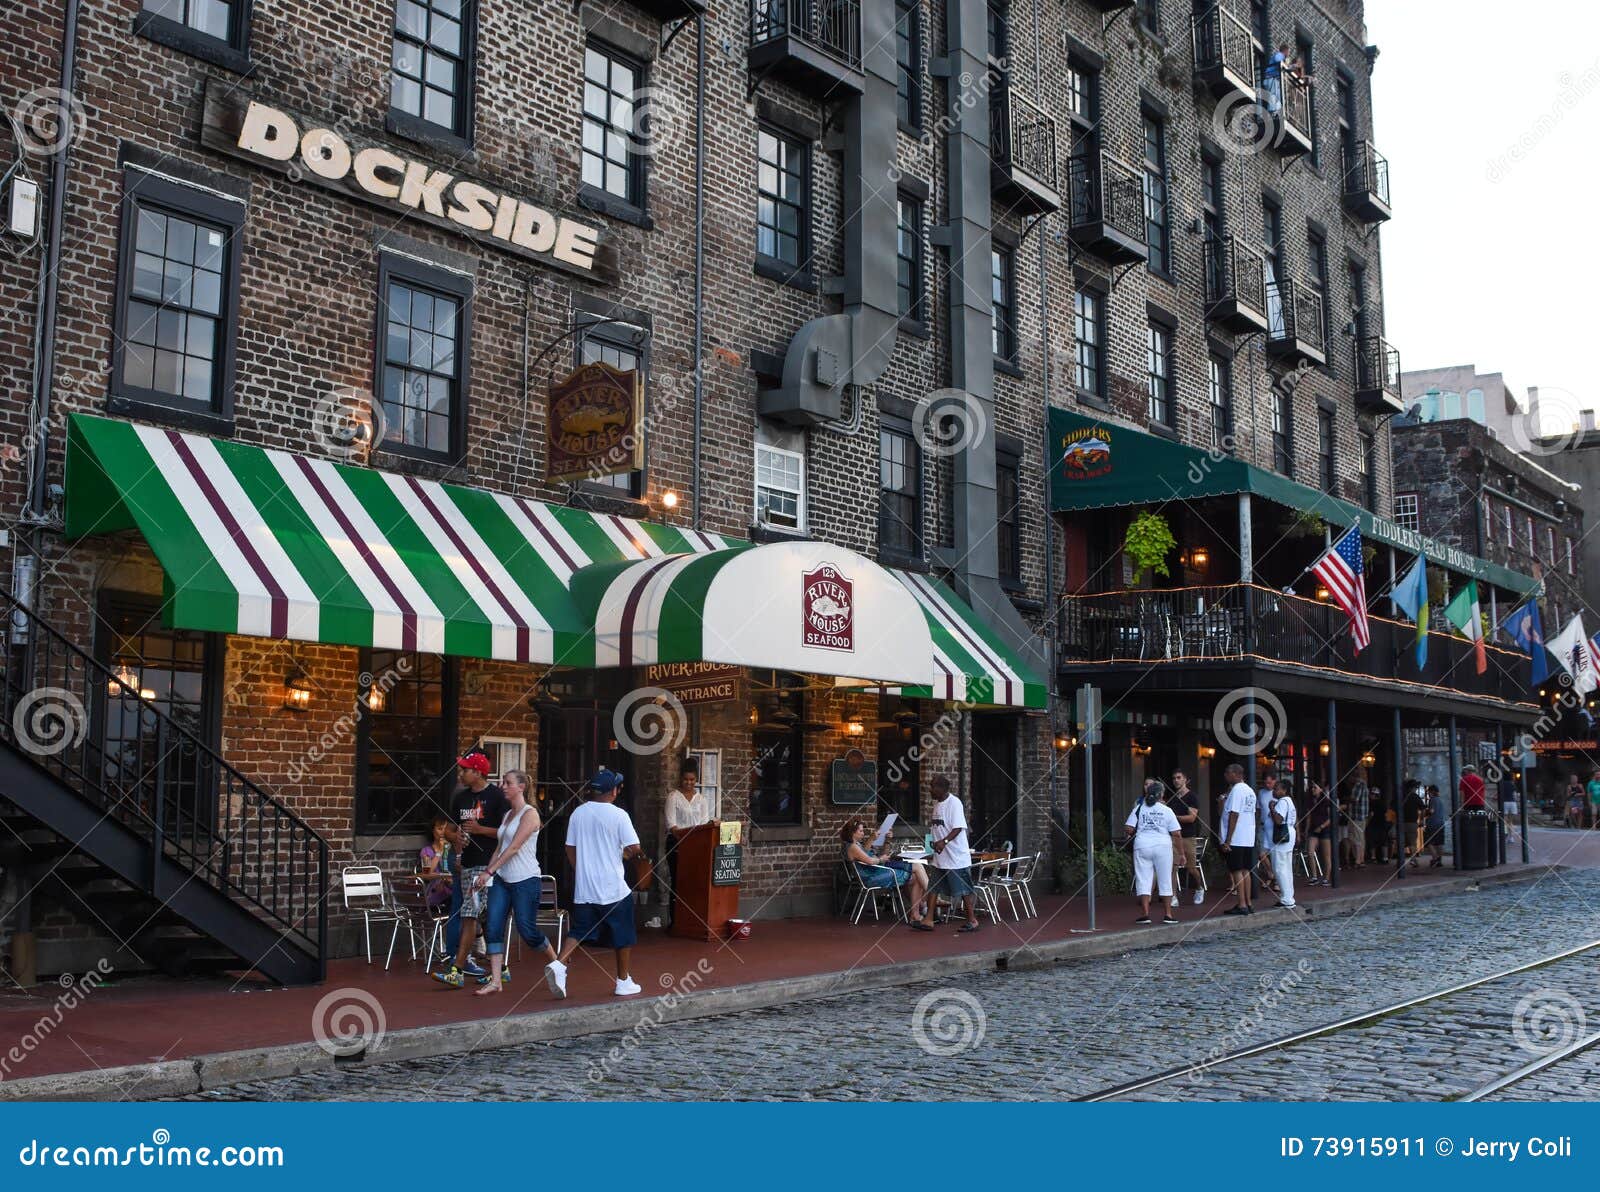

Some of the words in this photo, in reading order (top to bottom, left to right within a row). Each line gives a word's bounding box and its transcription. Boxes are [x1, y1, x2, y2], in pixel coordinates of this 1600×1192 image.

[238, 100, 598, 270] DOCKSIDE
[557, 386, 625, 417] RIVER
[559, 425, 620, 452] HOUSE
[1062, 427, 1111, 448] FIDDLERS
[1447, 547, 1476, 572] HOUSE
[822, 567, 836, 579] 125
[808, 583, 847, 607] RIVER
[809, 610, 846, 632] HOUSE
[807, 633, 850, 647] SEAFOOD
[649, 662, 692, 681] RIVER
[673, 684, 733, 702] ENTRANCE
[714, 869, 741, 879] SEATING
[720, 859, 737, 869] NOW
